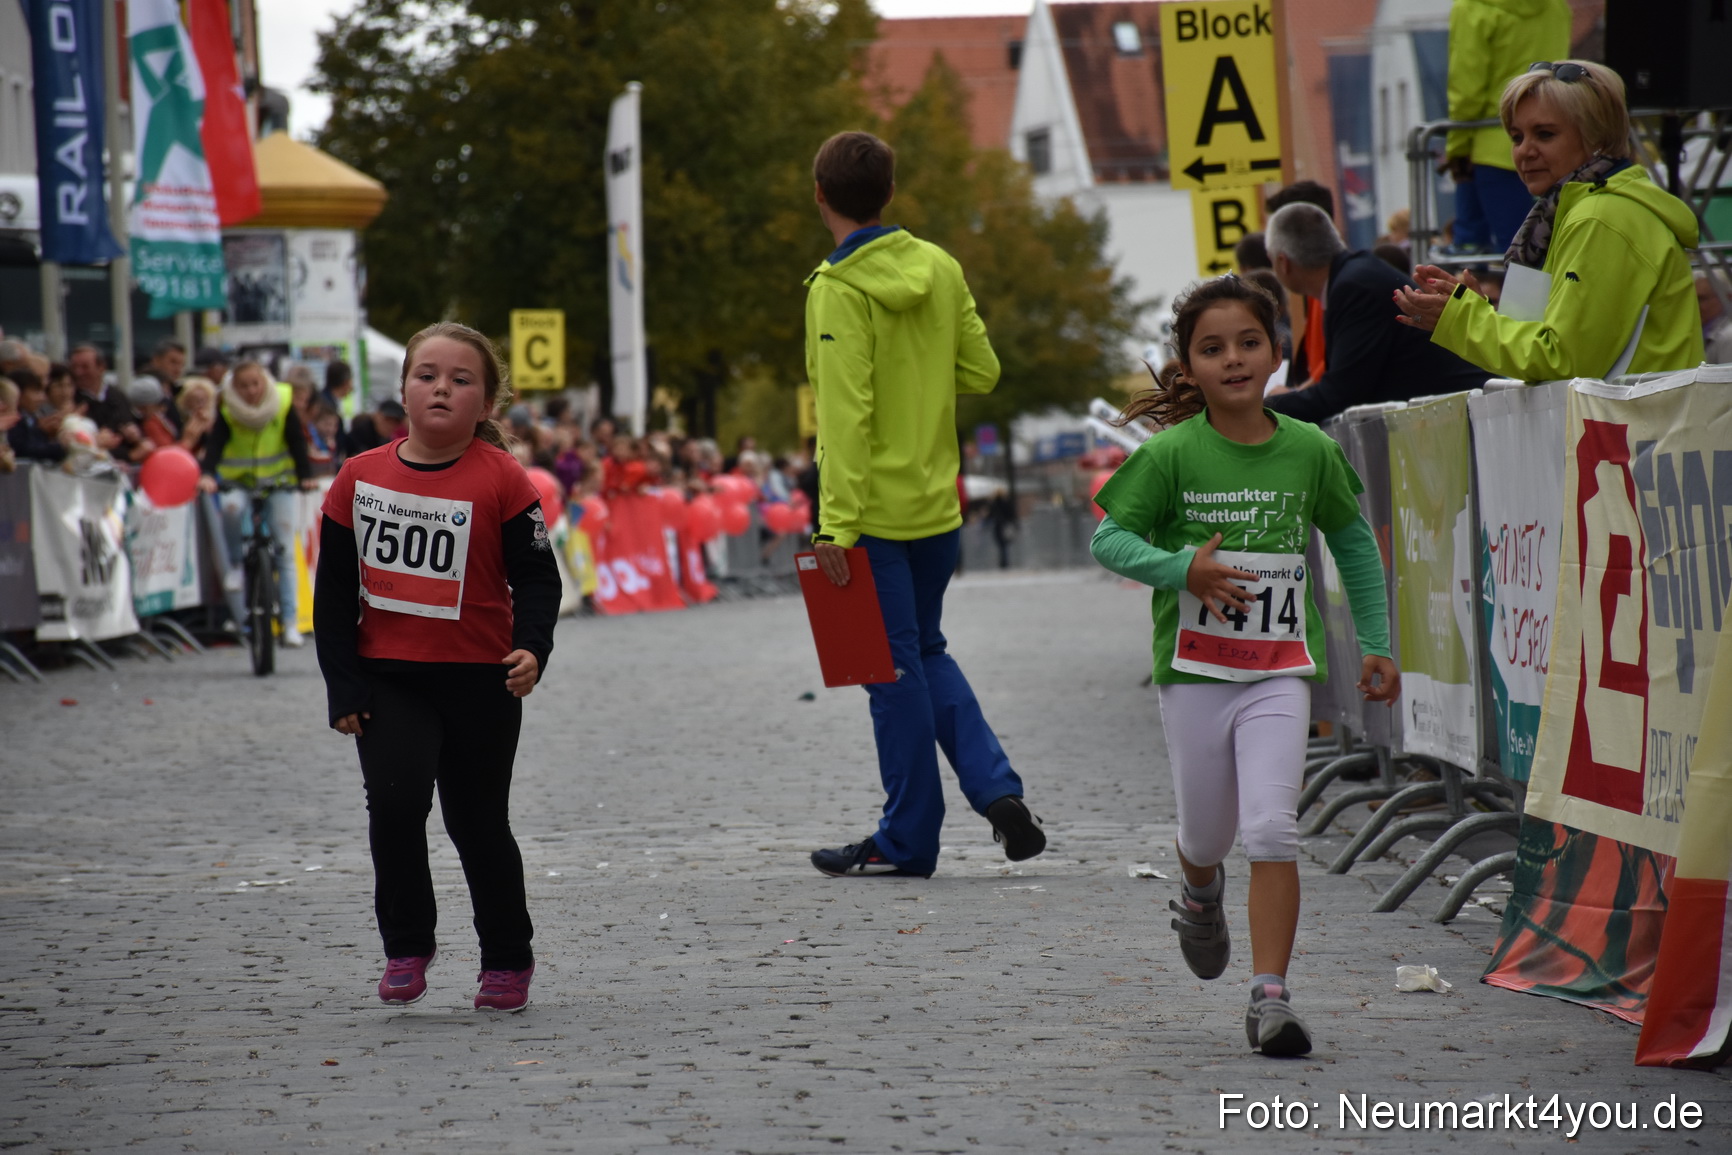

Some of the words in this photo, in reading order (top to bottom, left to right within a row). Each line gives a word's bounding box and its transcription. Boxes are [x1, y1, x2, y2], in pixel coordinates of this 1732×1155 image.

[1175, 3, 1273, 43] Block
[1194, 54, 1266, 147] A
[1210, 197, 1249, 253] B
[137, 245, 223, 274] Service
[525, 333, 550, 371] C
[355, 493, 385, 513] PARTL
[387, 503, 447, 523] Neumarkt
[1183, 488, 1278, 504] Neumarkter
[1185, 507, 1259, 524] Stadtlauf
[360, 513, 455, 573] 7500
